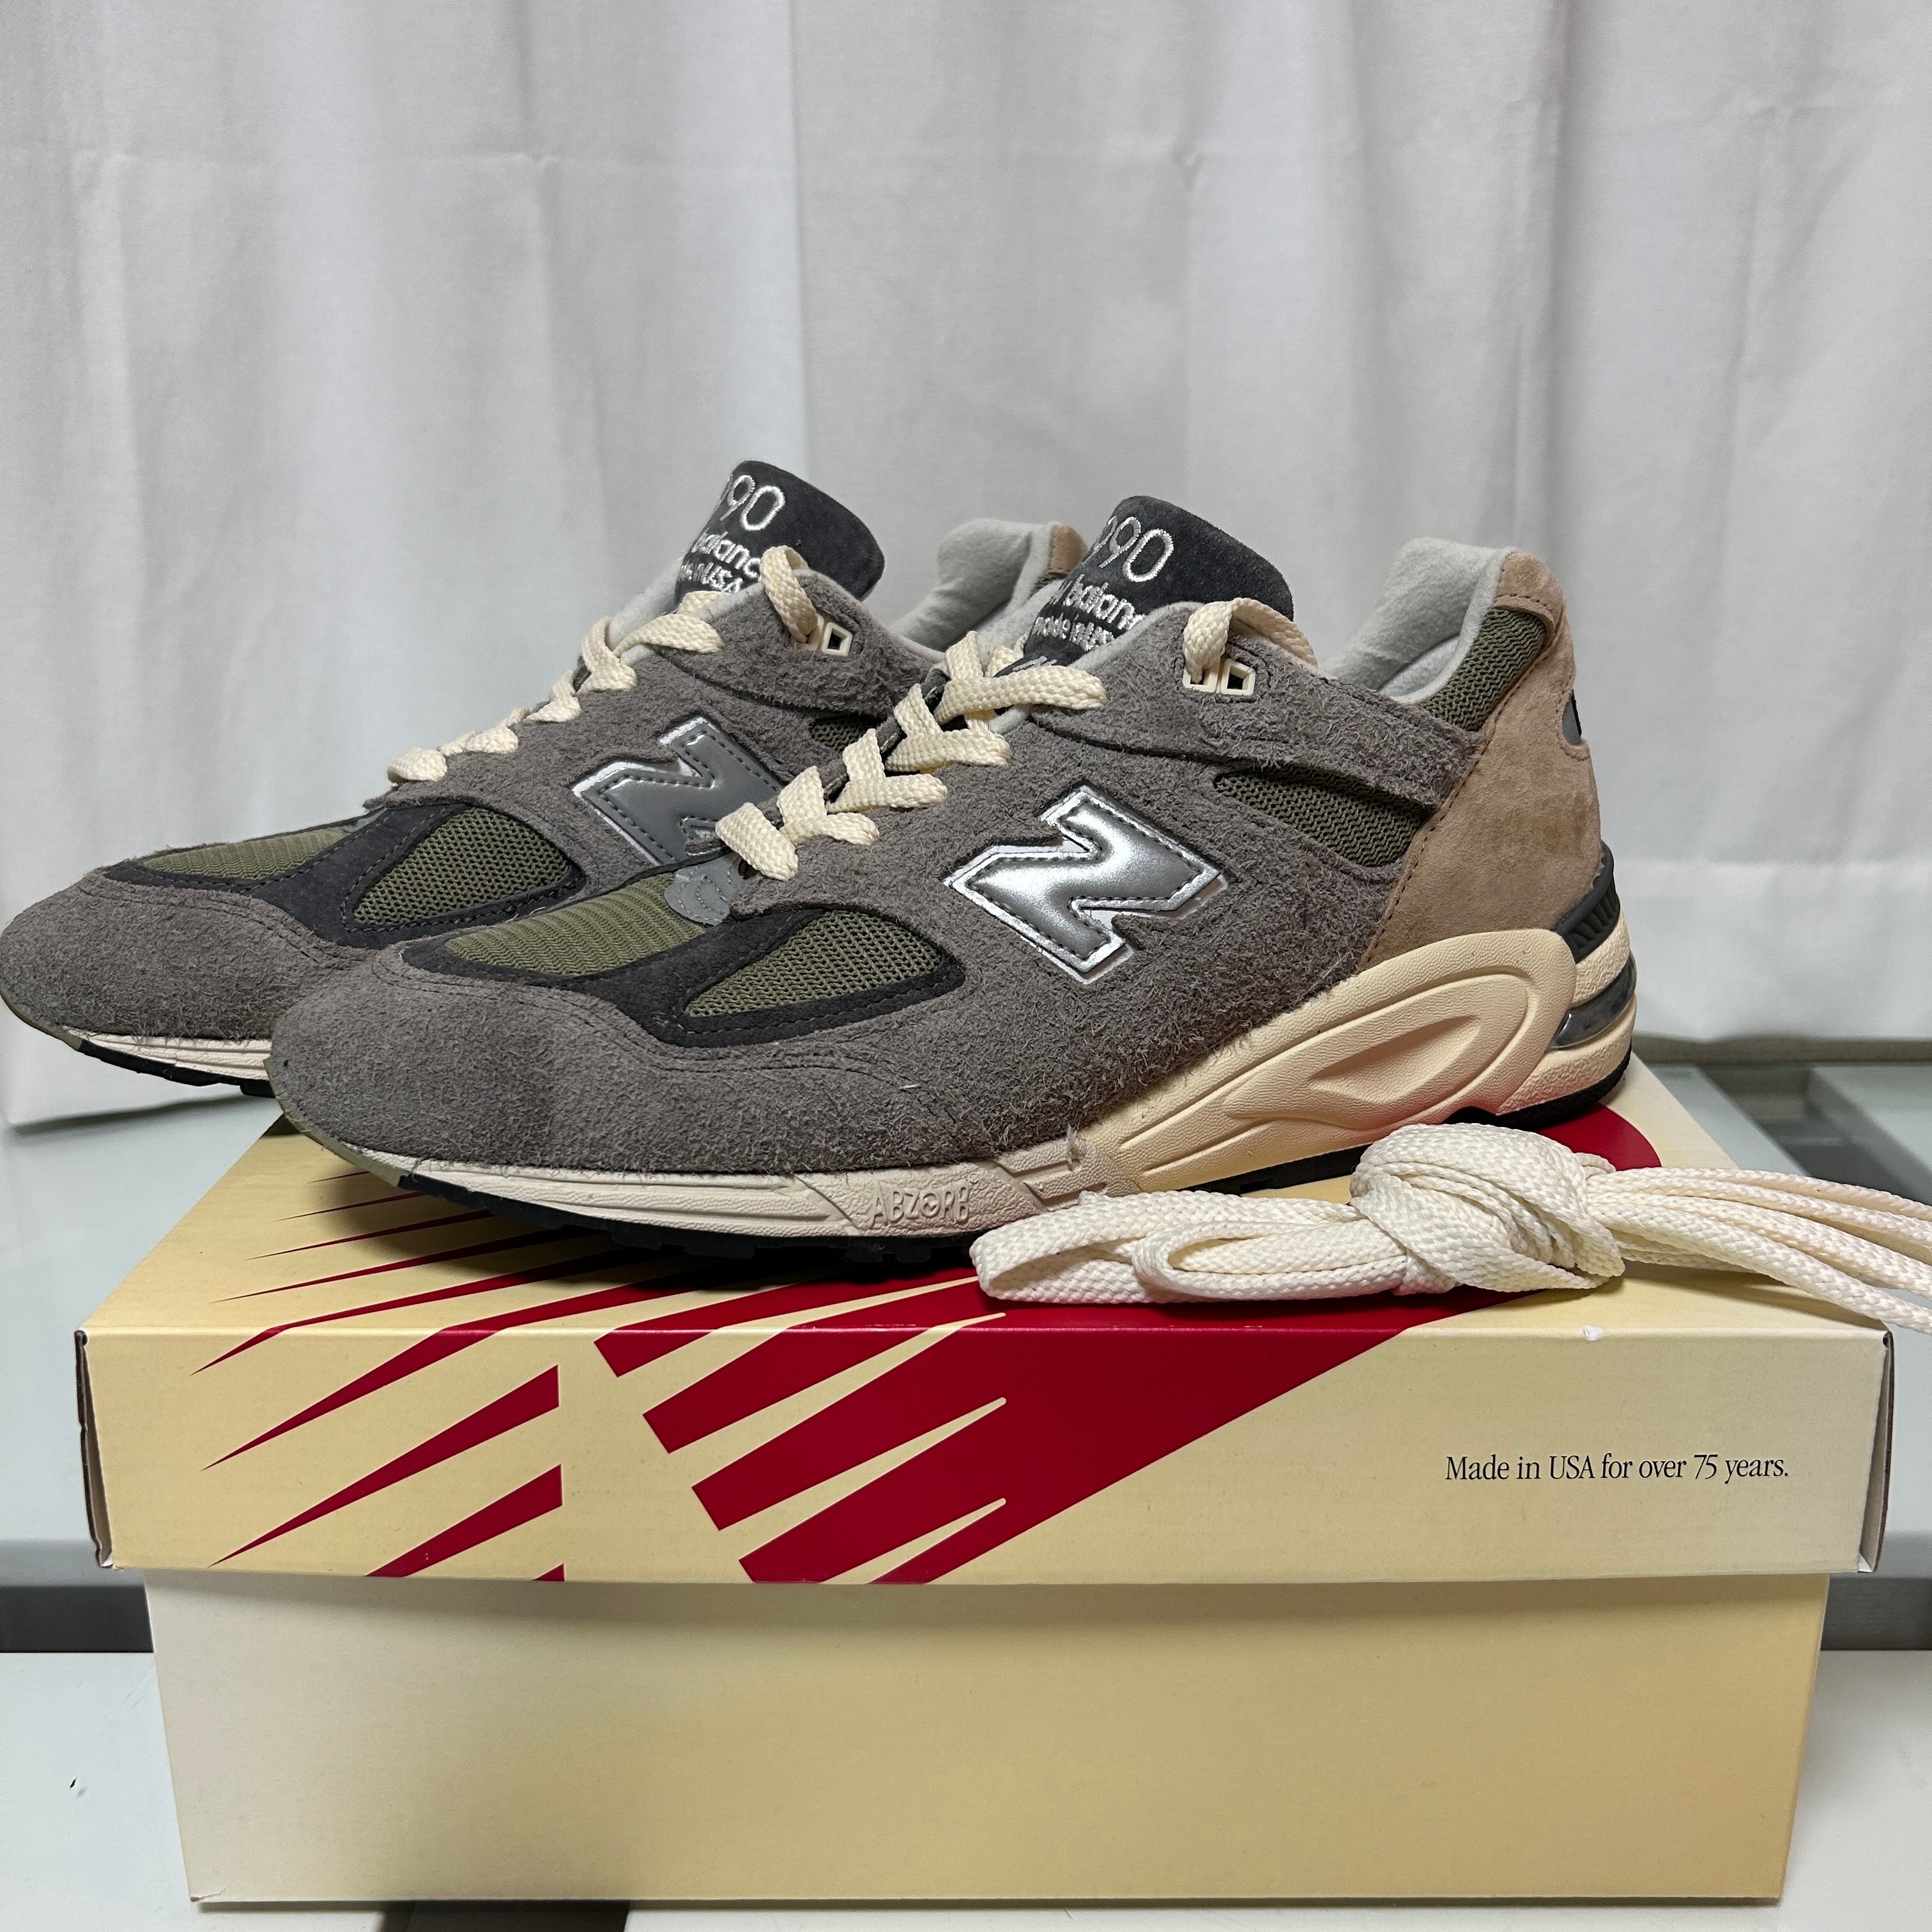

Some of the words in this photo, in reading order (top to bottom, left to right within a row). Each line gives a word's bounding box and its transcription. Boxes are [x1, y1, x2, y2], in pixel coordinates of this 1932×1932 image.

[944, 782, 1228, 984] N
[1445, 1453, 1510, 1480] Made
[1515, 1456, 1541, 1480] in
[1549, 1455, 1595, 1480] USA
[1600, 1452, 1633, 1479] for
[1638, 1460, 1687, 1478] over
[1693, 1454, 1719, 1480] 75
[1724, 1457, 1789, 1484] years.
